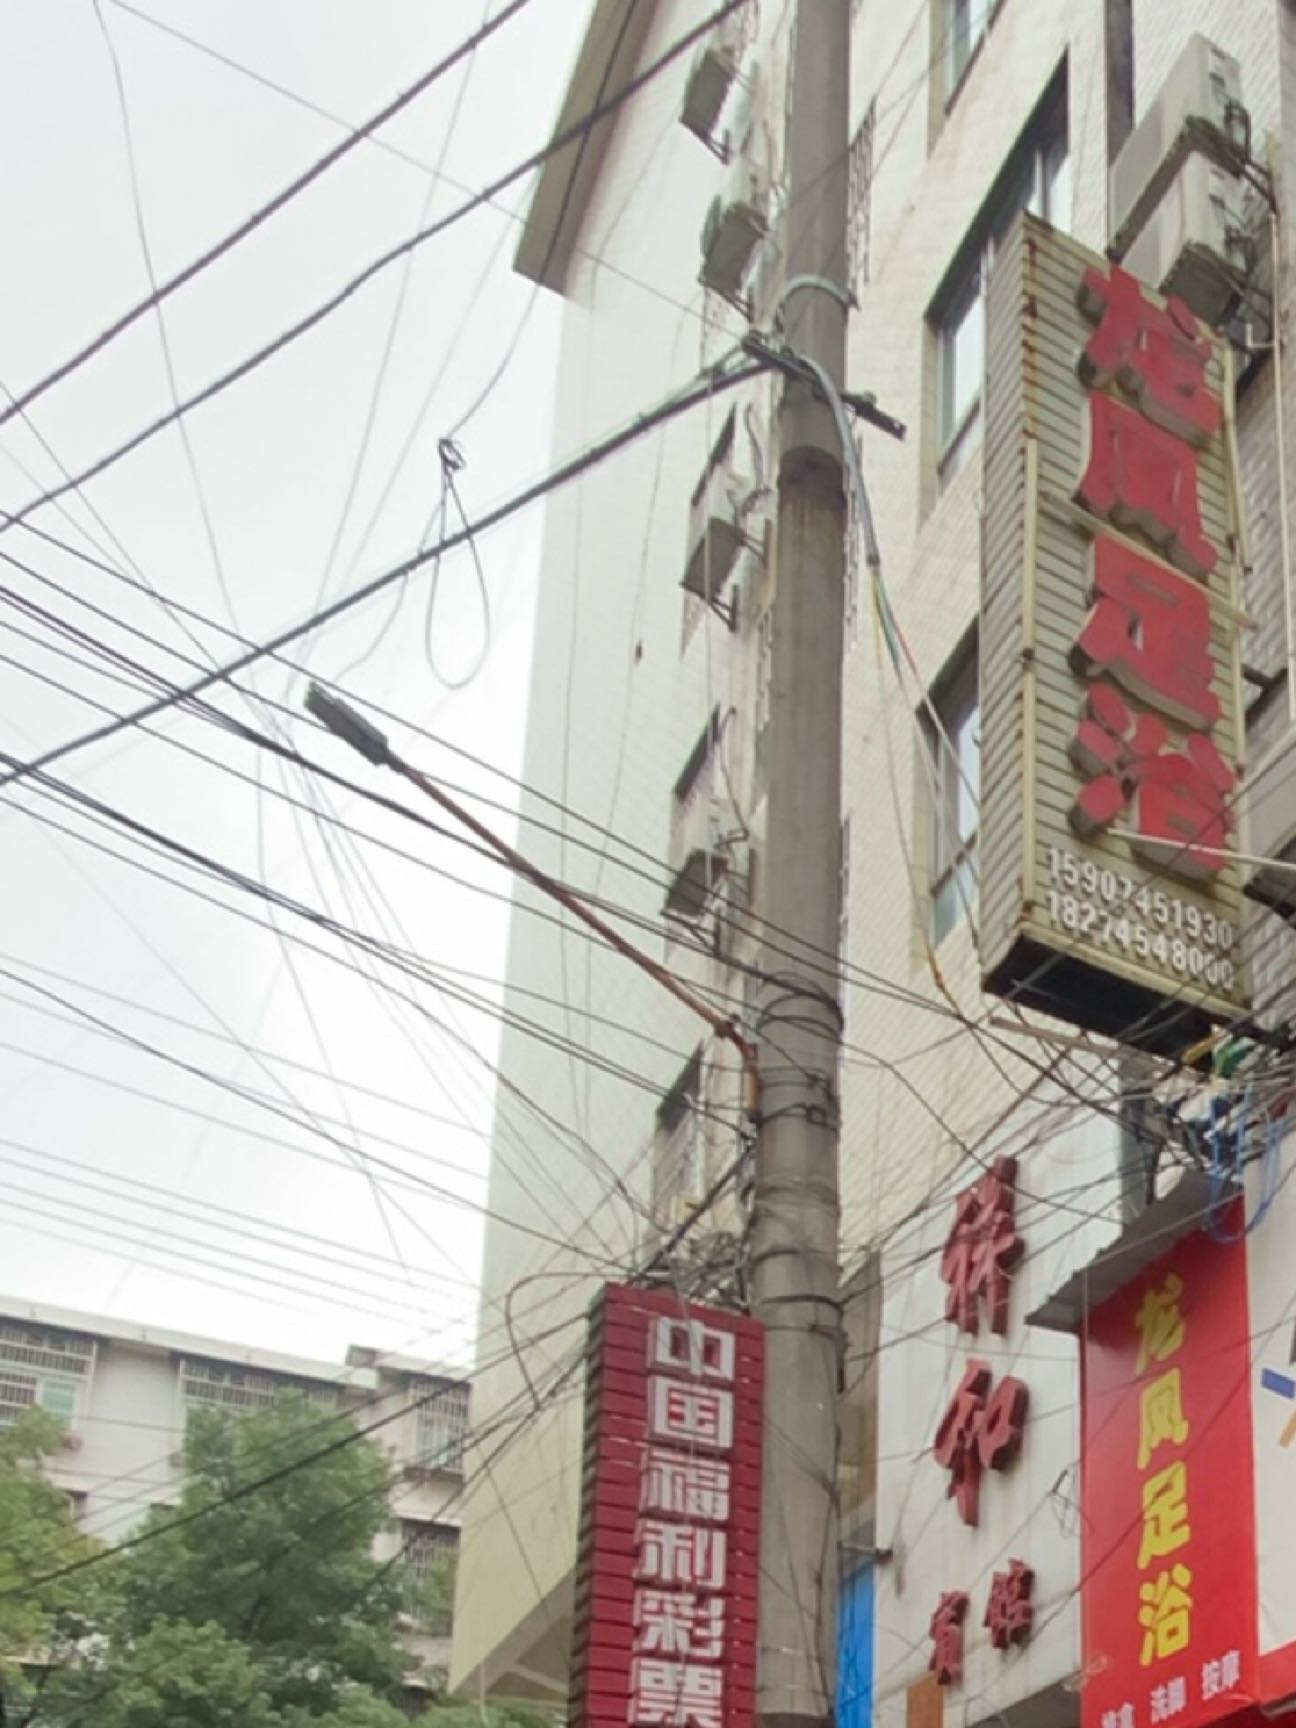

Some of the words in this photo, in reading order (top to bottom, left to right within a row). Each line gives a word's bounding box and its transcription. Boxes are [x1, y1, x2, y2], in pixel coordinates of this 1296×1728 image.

[1047, 848, 1232, 949] 15907451930
[1136, 1272, 1192, 1667] 龙凤足浴
